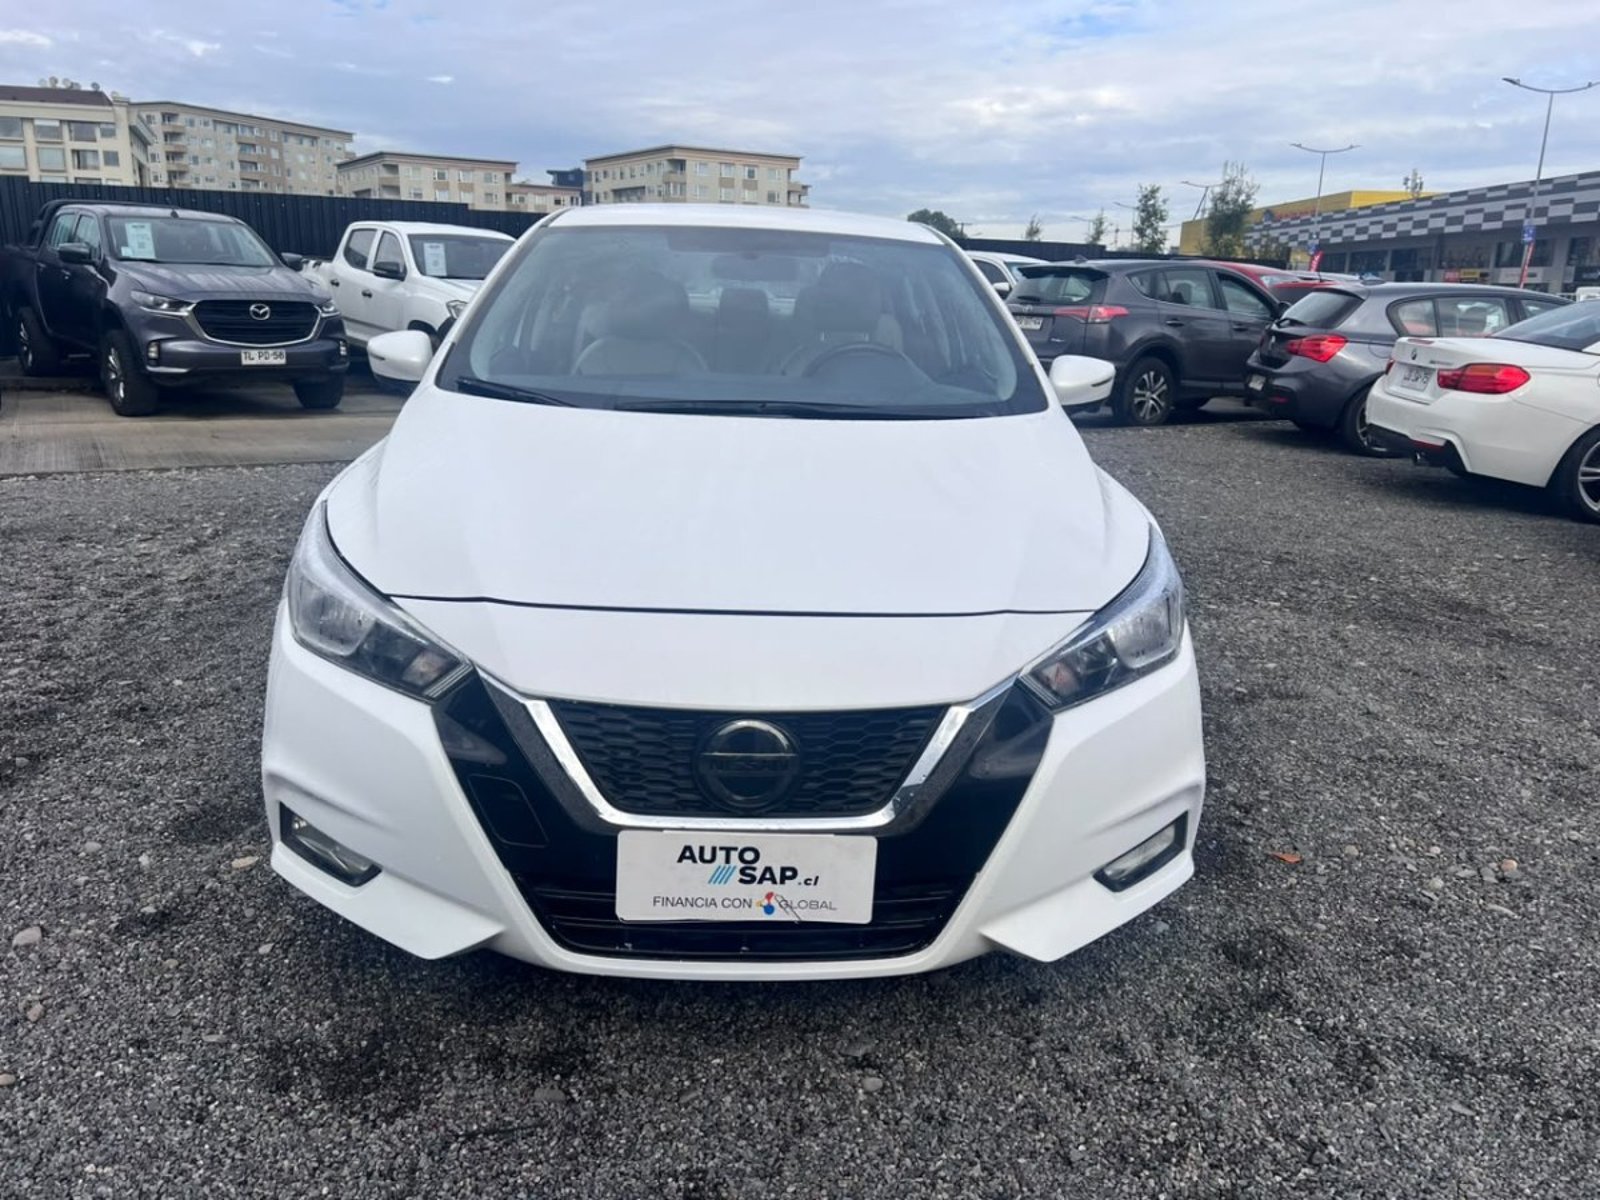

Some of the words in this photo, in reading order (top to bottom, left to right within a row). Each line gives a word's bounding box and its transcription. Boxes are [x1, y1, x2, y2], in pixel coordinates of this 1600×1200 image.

[709, 759, 789, 770] NISSAN
[677, 845, 760, 864] AUTO
[653, 896, 717, 909] FINANCIA
[721, 898, 752, 909] CON
[778, 899, 837, 911] GLOBAL
